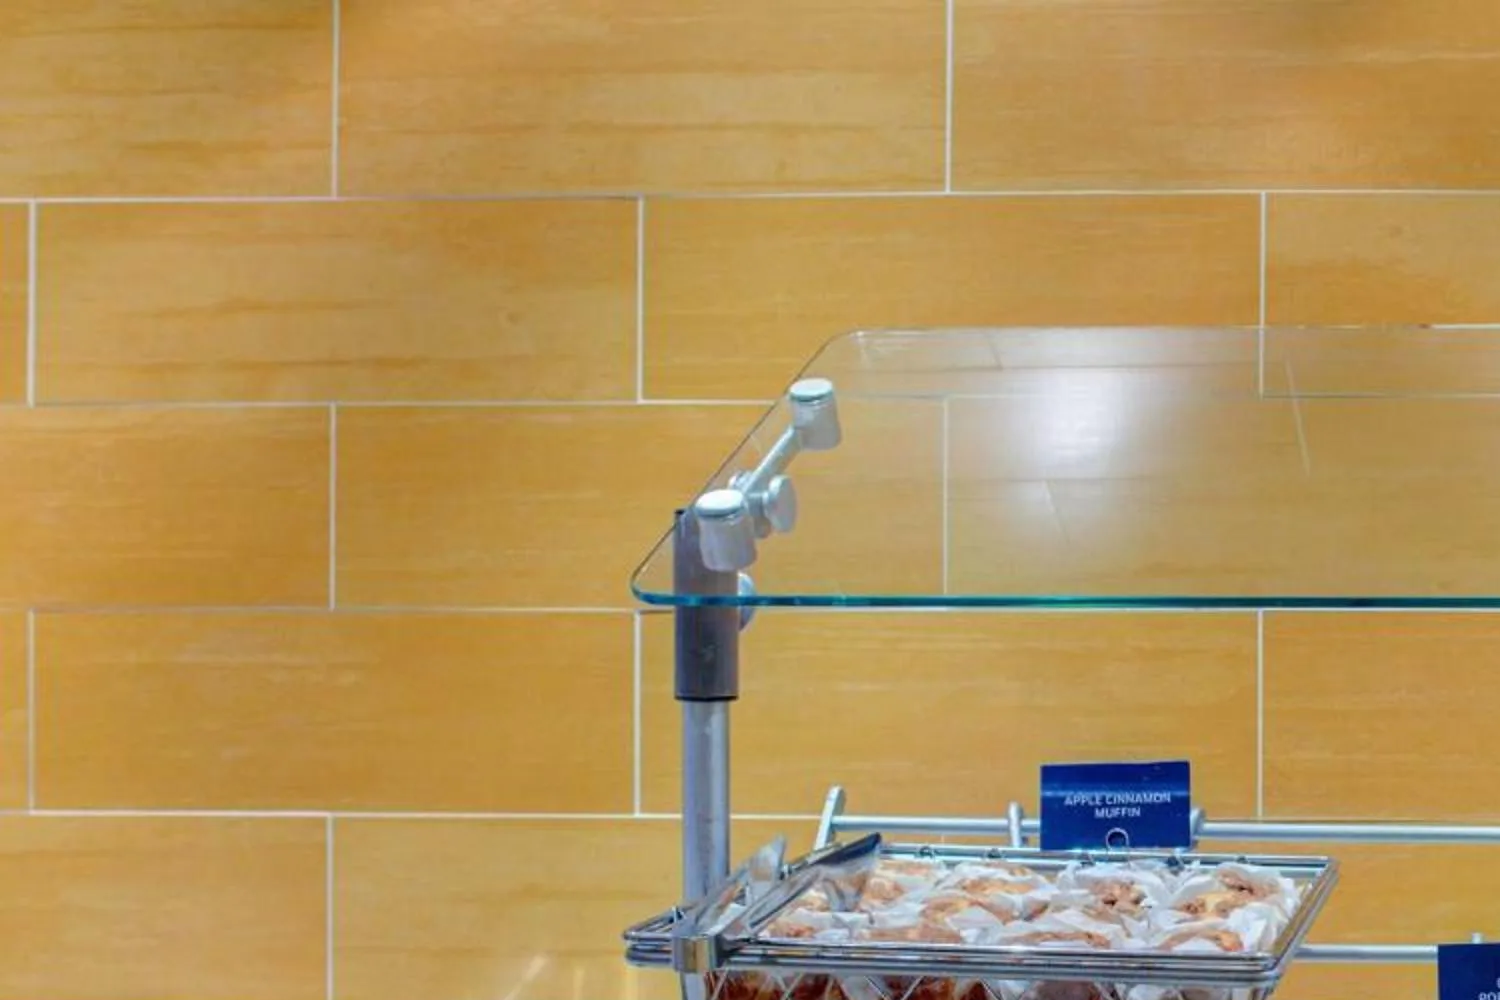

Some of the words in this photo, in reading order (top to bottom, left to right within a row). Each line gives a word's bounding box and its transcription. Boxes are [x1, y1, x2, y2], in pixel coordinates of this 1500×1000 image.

[1064, 792, 1102, 806] APPLE
[1105, 791, 1171, 805] CINNAMON
[1094, 807, 1141, 819] MUFFIN
